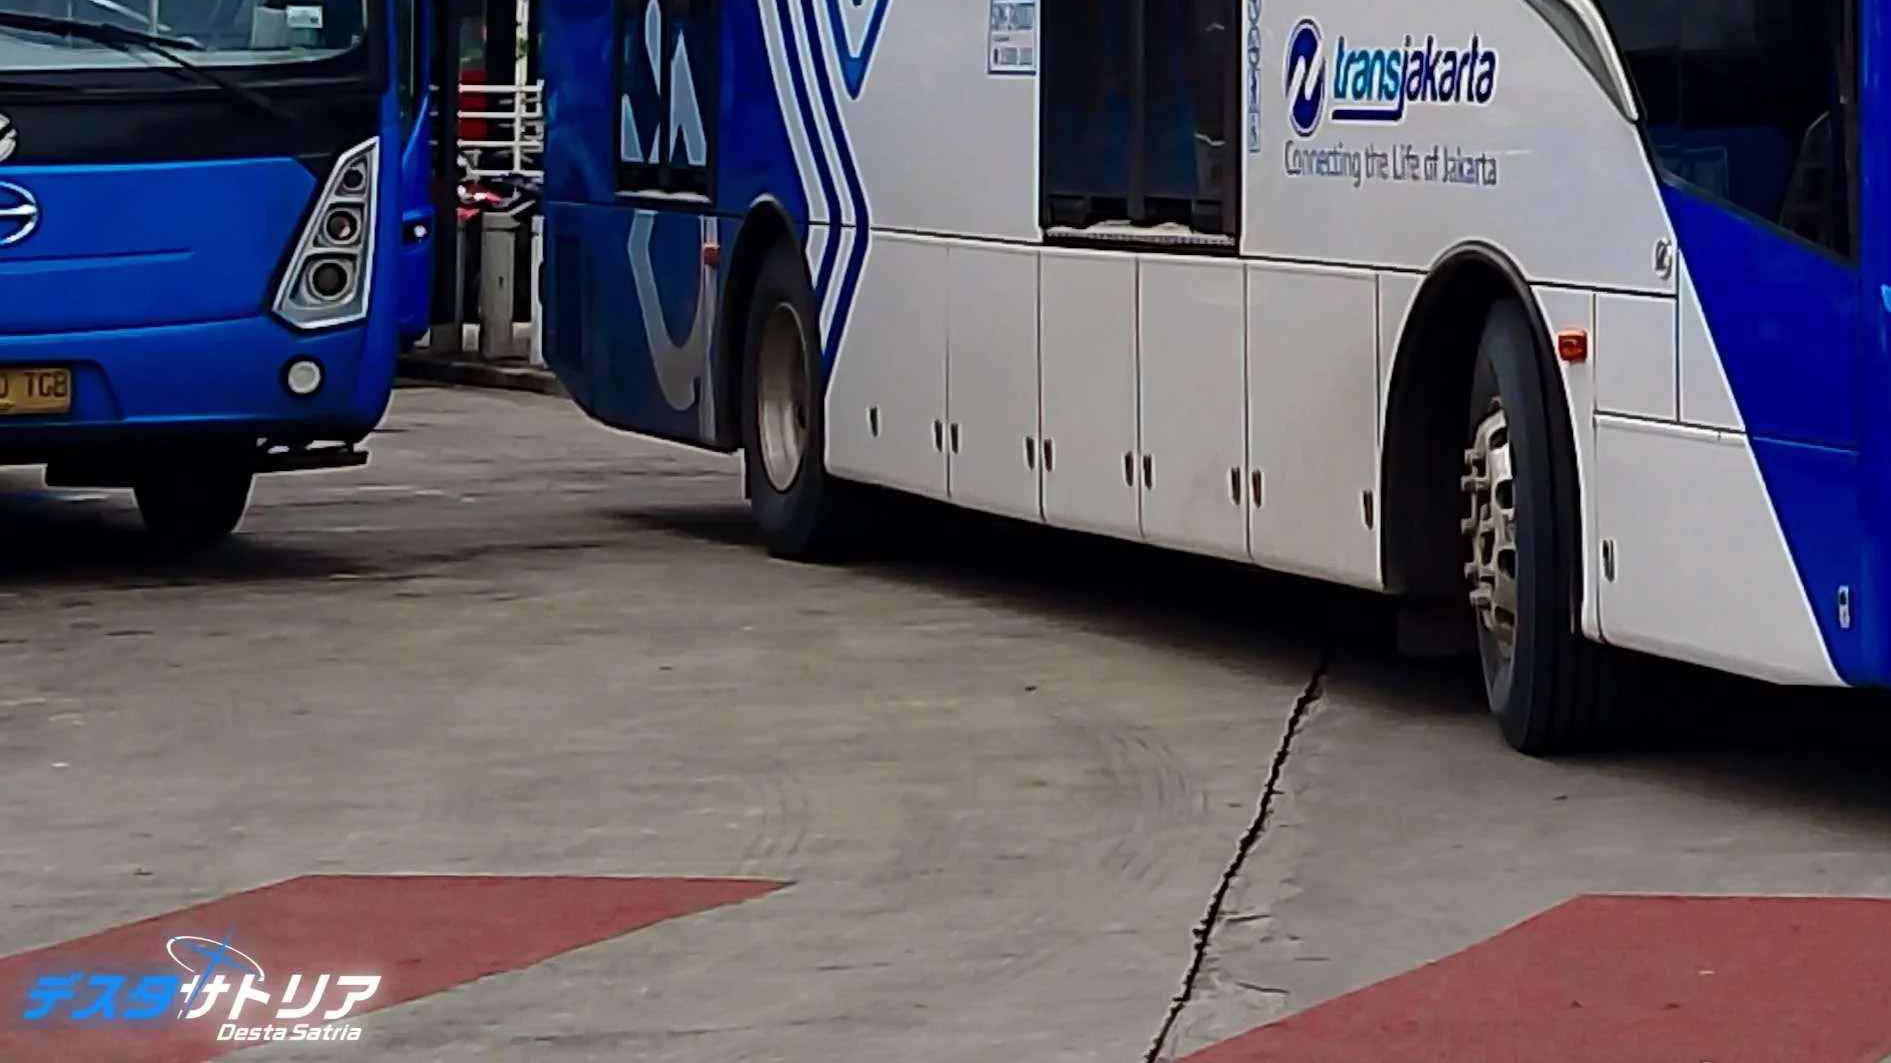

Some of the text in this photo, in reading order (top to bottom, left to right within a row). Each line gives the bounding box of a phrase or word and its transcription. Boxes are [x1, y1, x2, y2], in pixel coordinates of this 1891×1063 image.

[1331, 34, 1497, 120] transjakarta
[1365, 143, 1389, 179] the
[1393, 143, 1420, 180] Life
